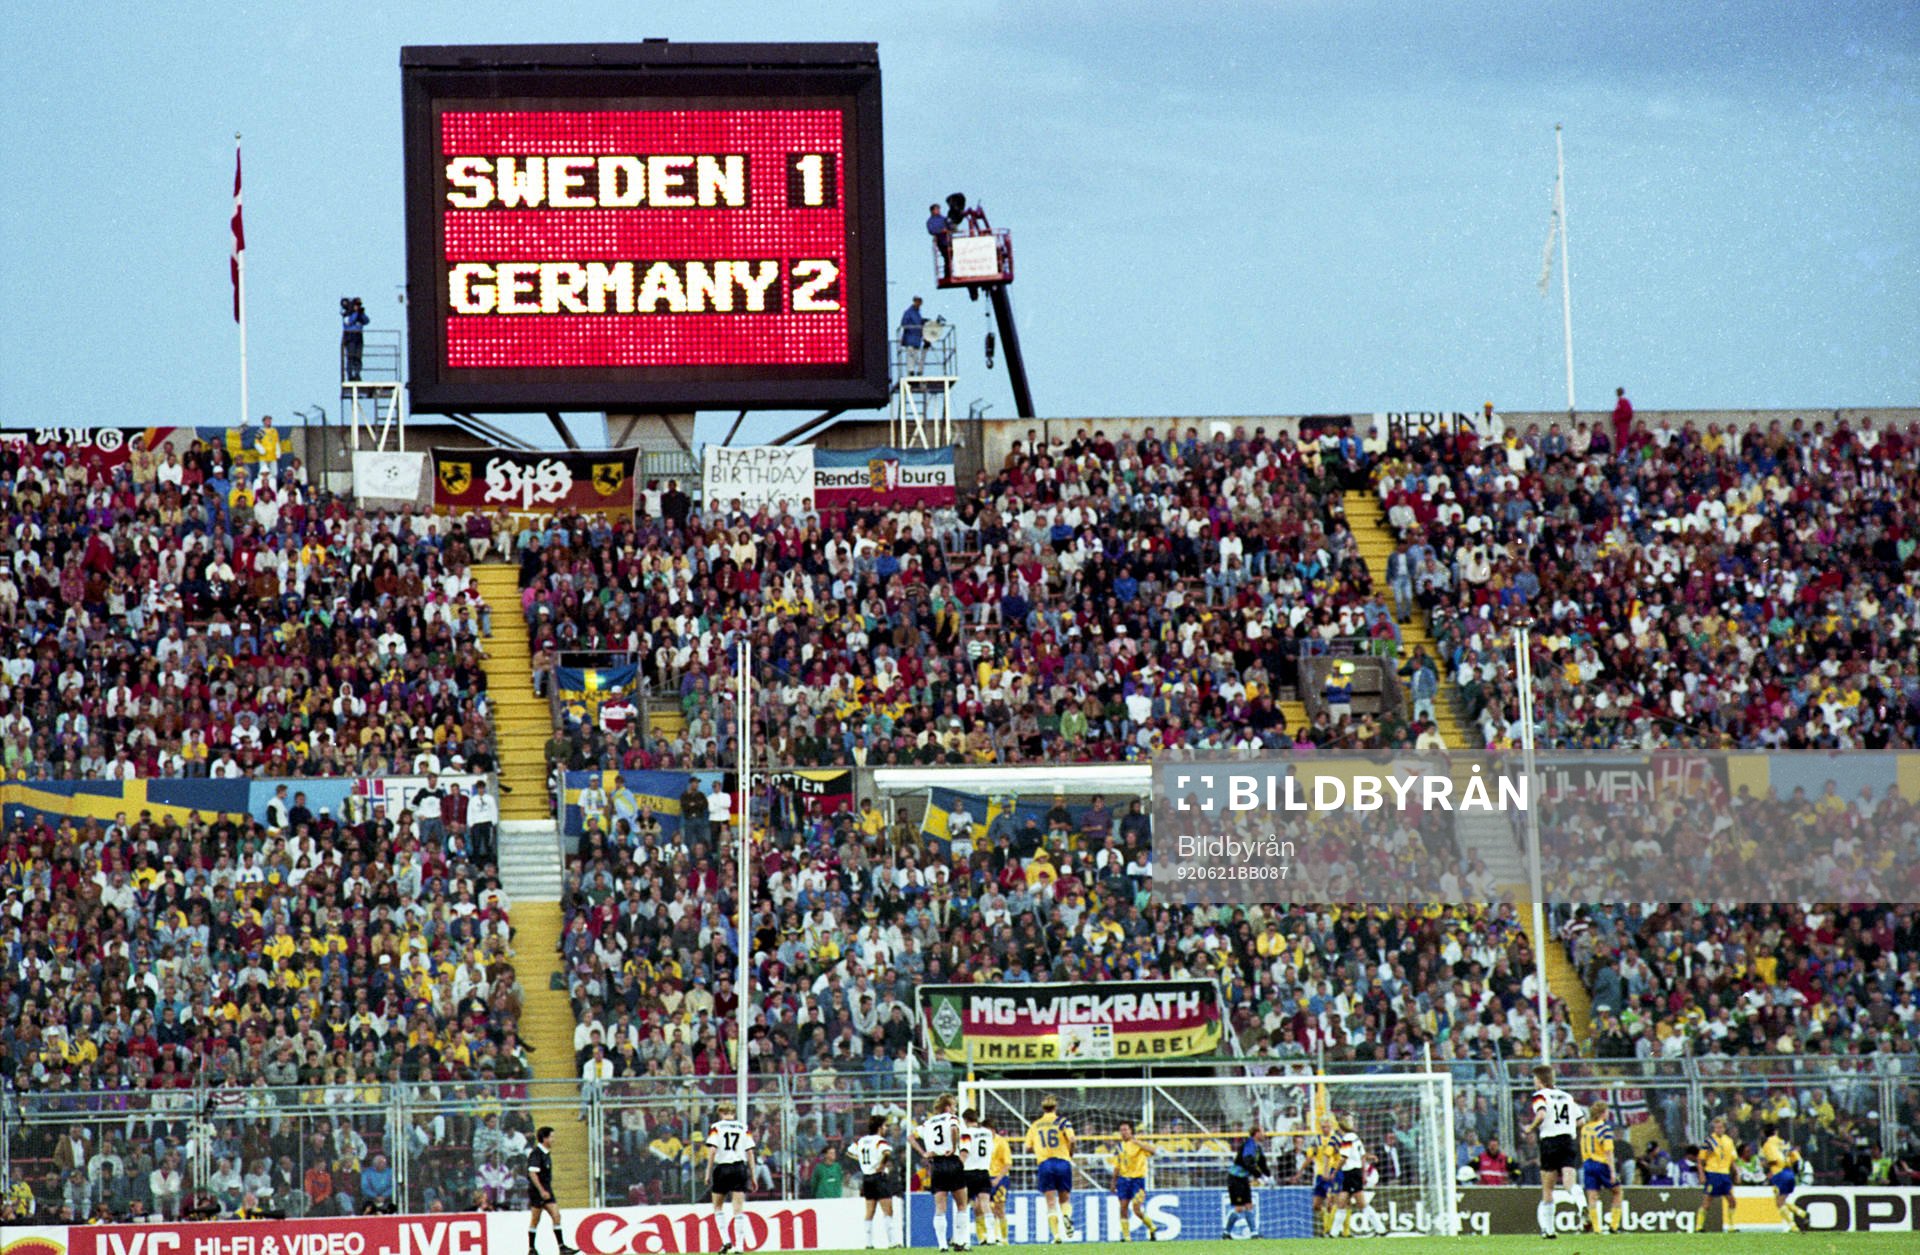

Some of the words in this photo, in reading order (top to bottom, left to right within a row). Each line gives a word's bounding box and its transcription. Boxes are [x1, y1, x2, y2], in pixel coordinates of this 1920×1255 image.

[445, 155, 746, 209] SWEDEN
[795, 154, 824, 206] 1
[448, 261, 780, 314] GERMANY
[792, 260, 841, 312] 2
[716, 450, 795, 466] HAPPY
[711, 466, 808, 484] BIRTHDAY
[815, 472, 869, 486] Rends
[902, 468, 946, 486] burg
[1522, 766, 1654, 802] ÜLMEN
[970, 990, 1200, 1025] MG-WICKRATH
[980, 1042, 1055, 1058] IMMER
[1117, 1035, 1193, 1055] DABEI
[1553, 1103, 1569, 1124] 14
[723, 1131, 740, 1151] 17
[933, 1124, 944, 1146] 3
[1038, 1129, 1059, 1148] 16
[1583, 1134, 1596, 1154] 11
[861, 1148, 871, 1165] 11
[978, 1139, 987, 1157] 6
[968, 1194, 1182, 1243] HILIPS
[1349, 1201, 1491, 1236] alsbrg
[1552, 1190, 1695, 1233] alberg
[1794, 1194, 1920, 1231] OP
[195, 1236, 255, 1255] HI-FI
[260, 1235, 279, 1255] &
[283, 1232, 365, 1255] VIDEO
[379, 1221, 481, 1255] JVC
[575, 1208, 818, 1255] Canon
